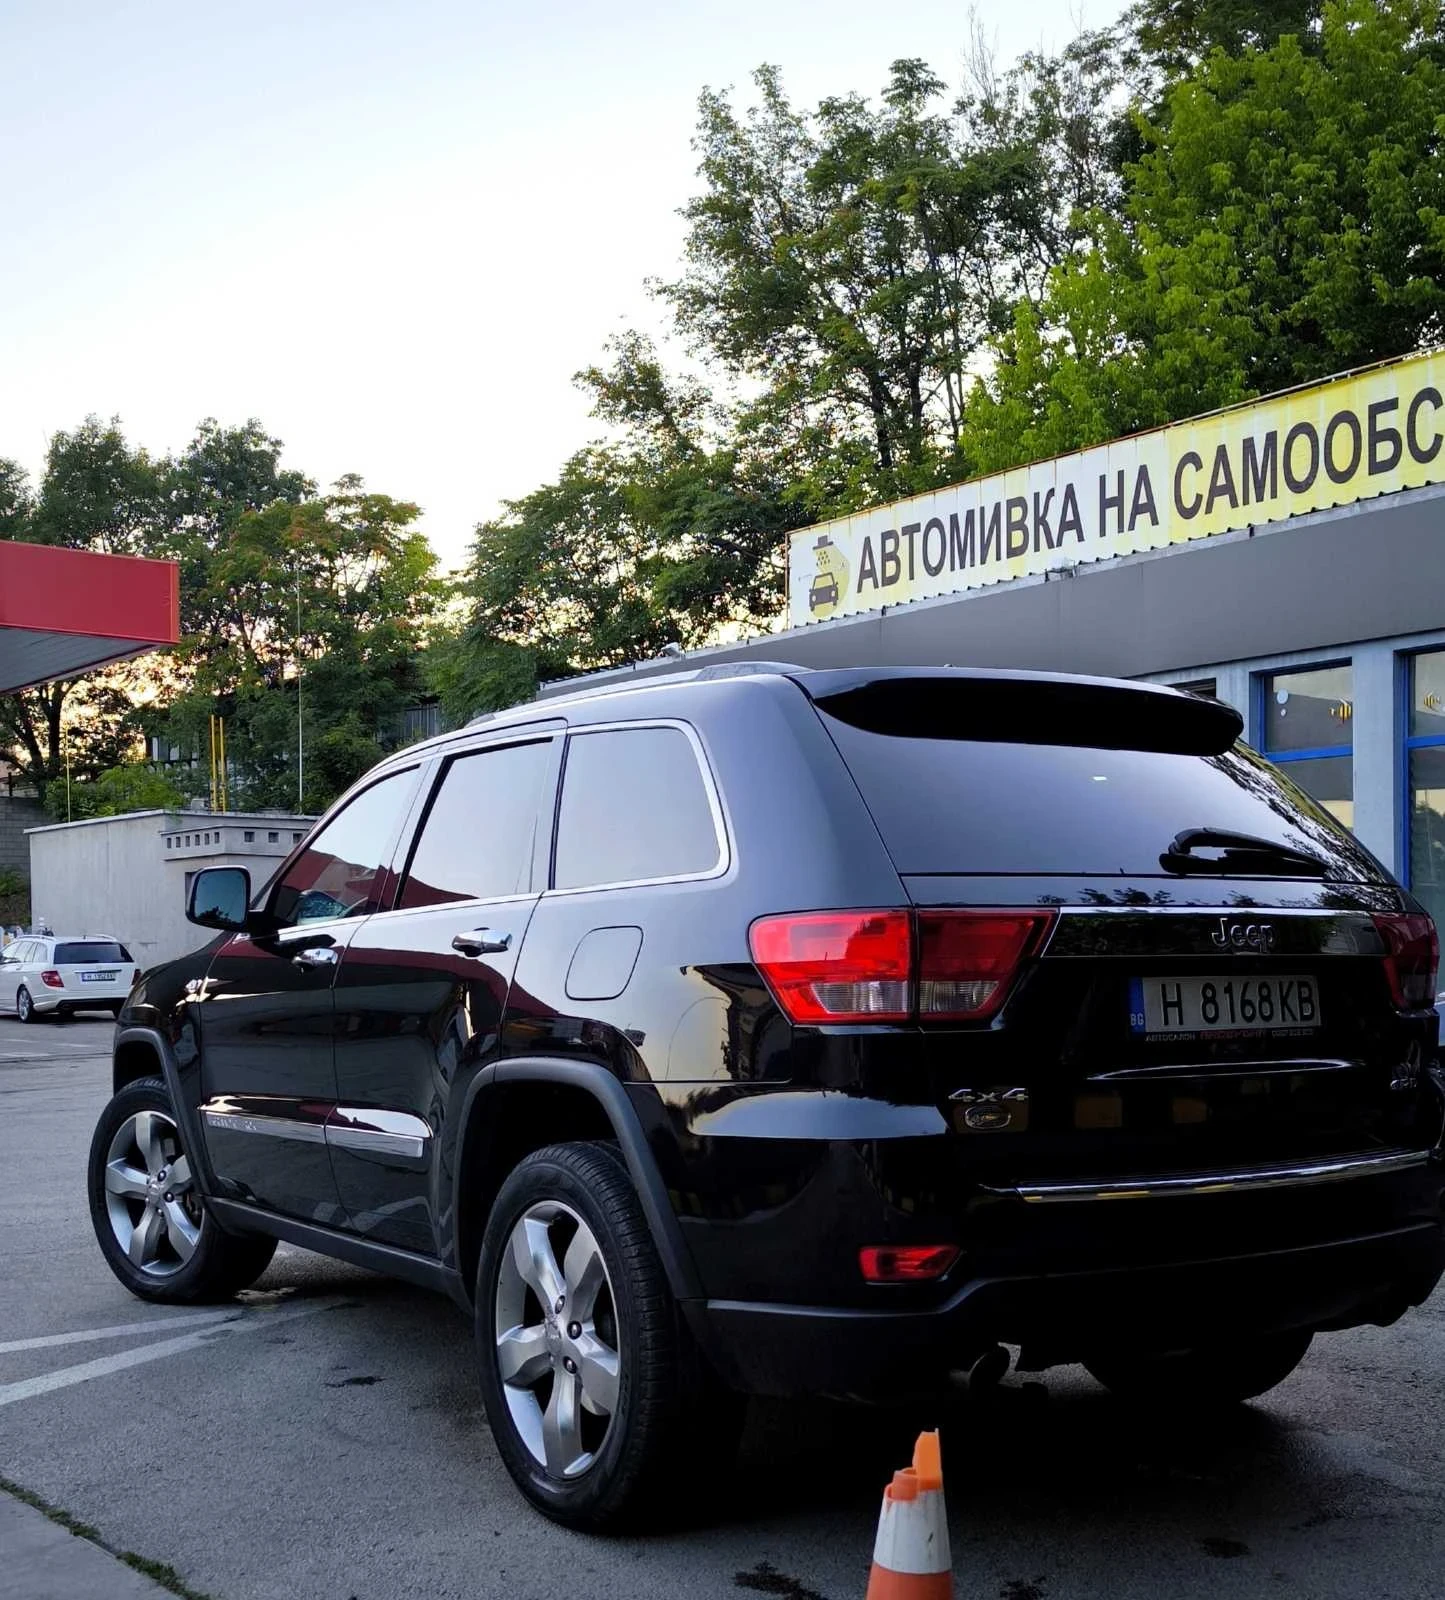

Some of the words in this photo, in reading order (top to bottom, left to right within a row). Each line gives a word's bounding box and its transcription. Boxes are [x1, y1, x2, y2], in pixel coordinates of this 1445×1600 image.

[857, 484, 1085, 593] АВТОМИВКА
[1099, 465, 1159, 538] НА
[1174, 387, 1443, 521] САМООБС
[1211, 917, 1275, 952] Jeep
[1130, 1013, 1144, 1027] BG
